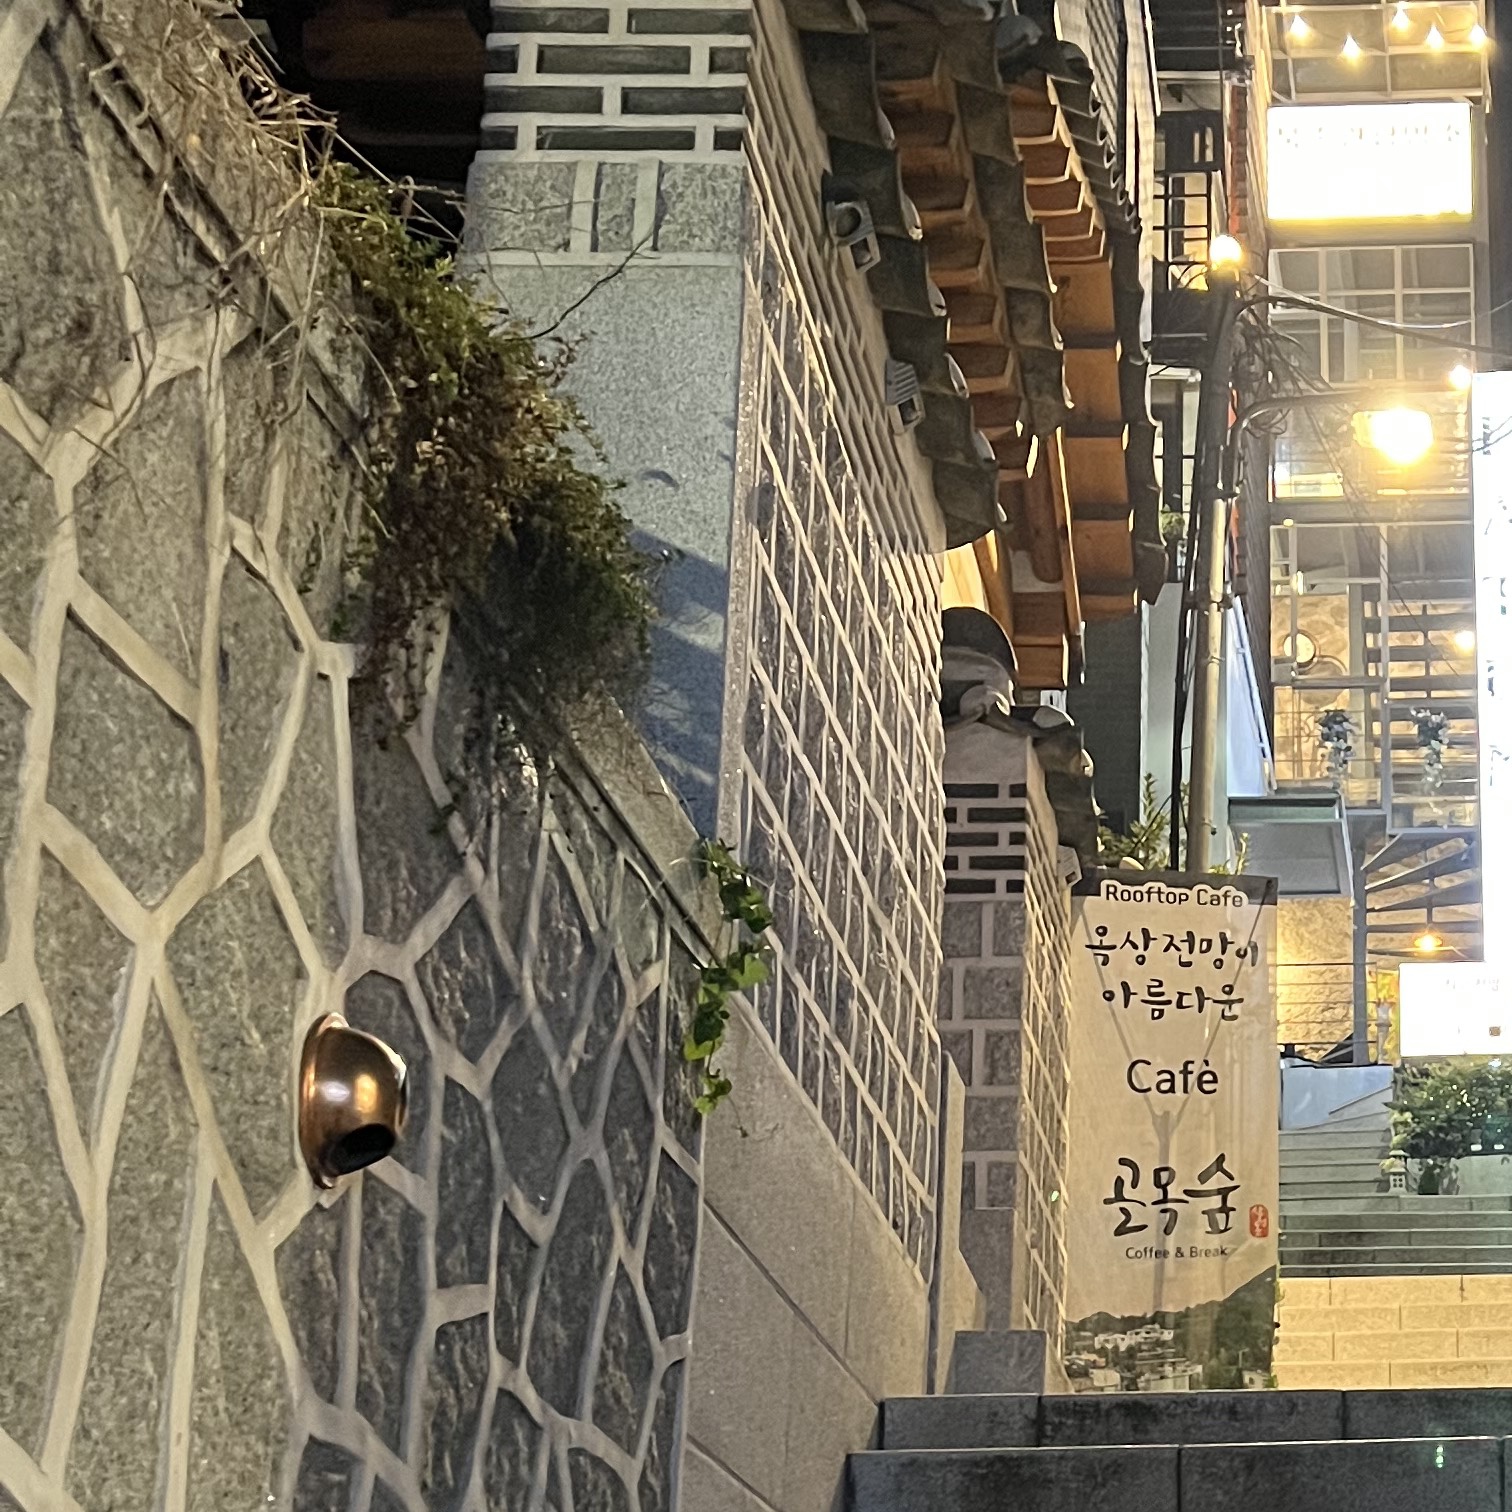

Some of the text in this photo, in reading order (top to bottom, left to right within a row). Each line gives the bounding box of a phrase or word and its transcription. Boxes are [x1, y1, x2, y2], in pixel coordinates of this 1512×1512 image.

[1105, 883, 1244, 908] Rooftop Cafe
[1102, 978, 1245, 1021] 아름다운
[1125, 1246, 1229, 1260] Coffee & Break
